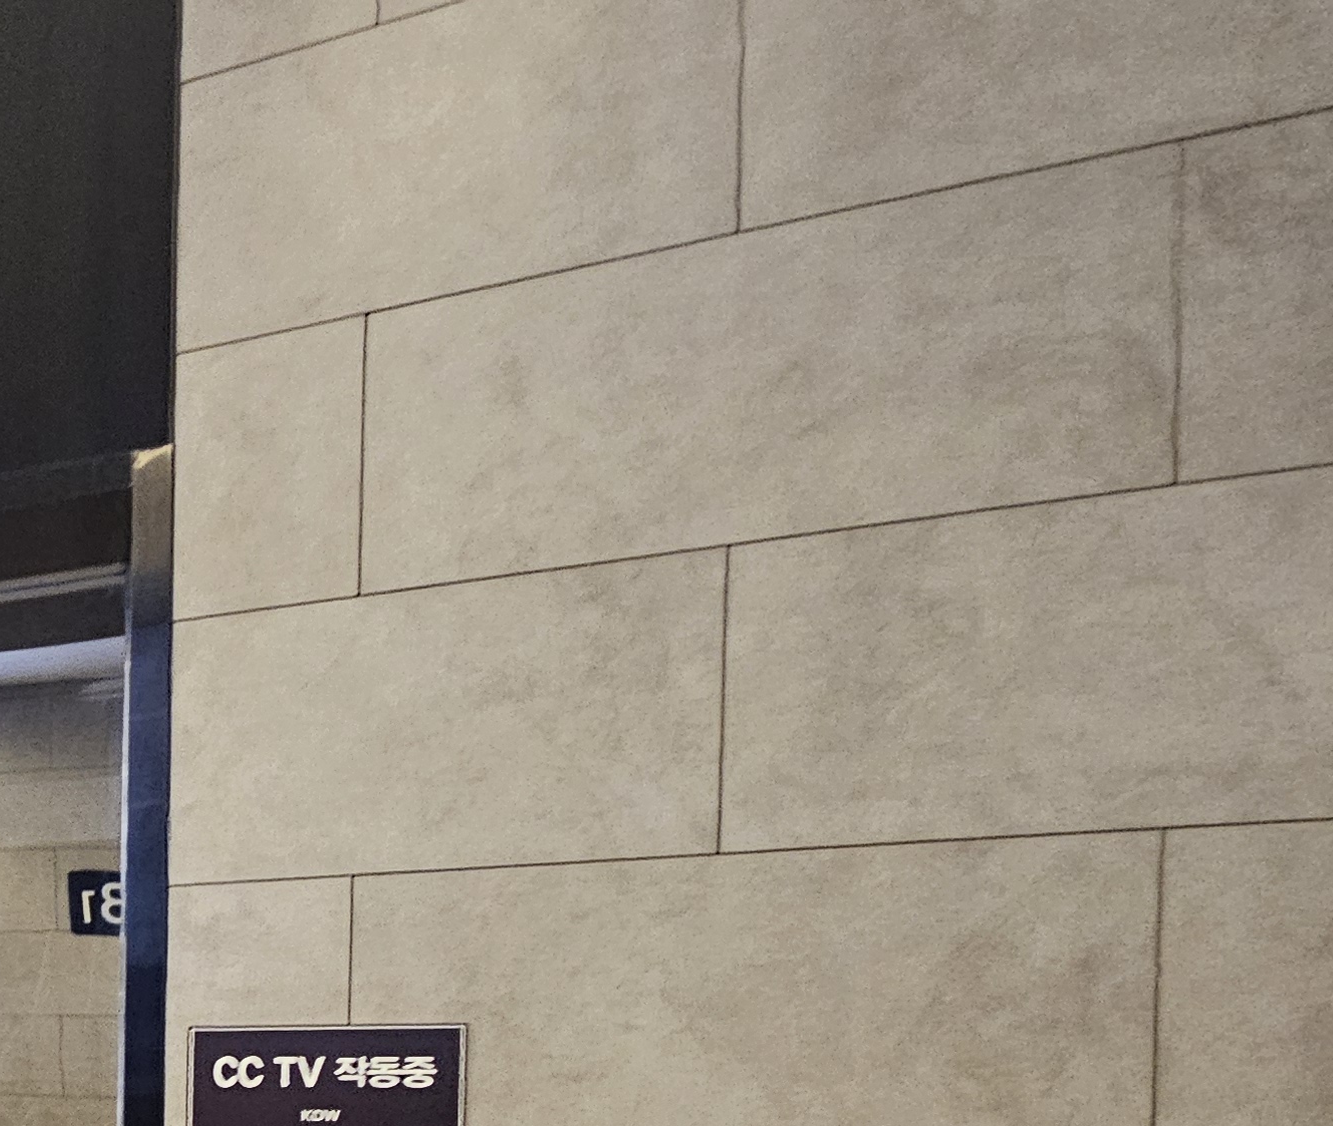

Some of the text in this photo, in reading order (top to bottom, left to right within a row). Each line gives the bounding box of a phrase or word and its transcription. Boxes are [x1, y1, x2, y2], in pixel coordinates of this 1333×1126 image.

[212, 1055, 438, 1089] CC TV 작동중
[300, 1108, 341, 1122] KDW
